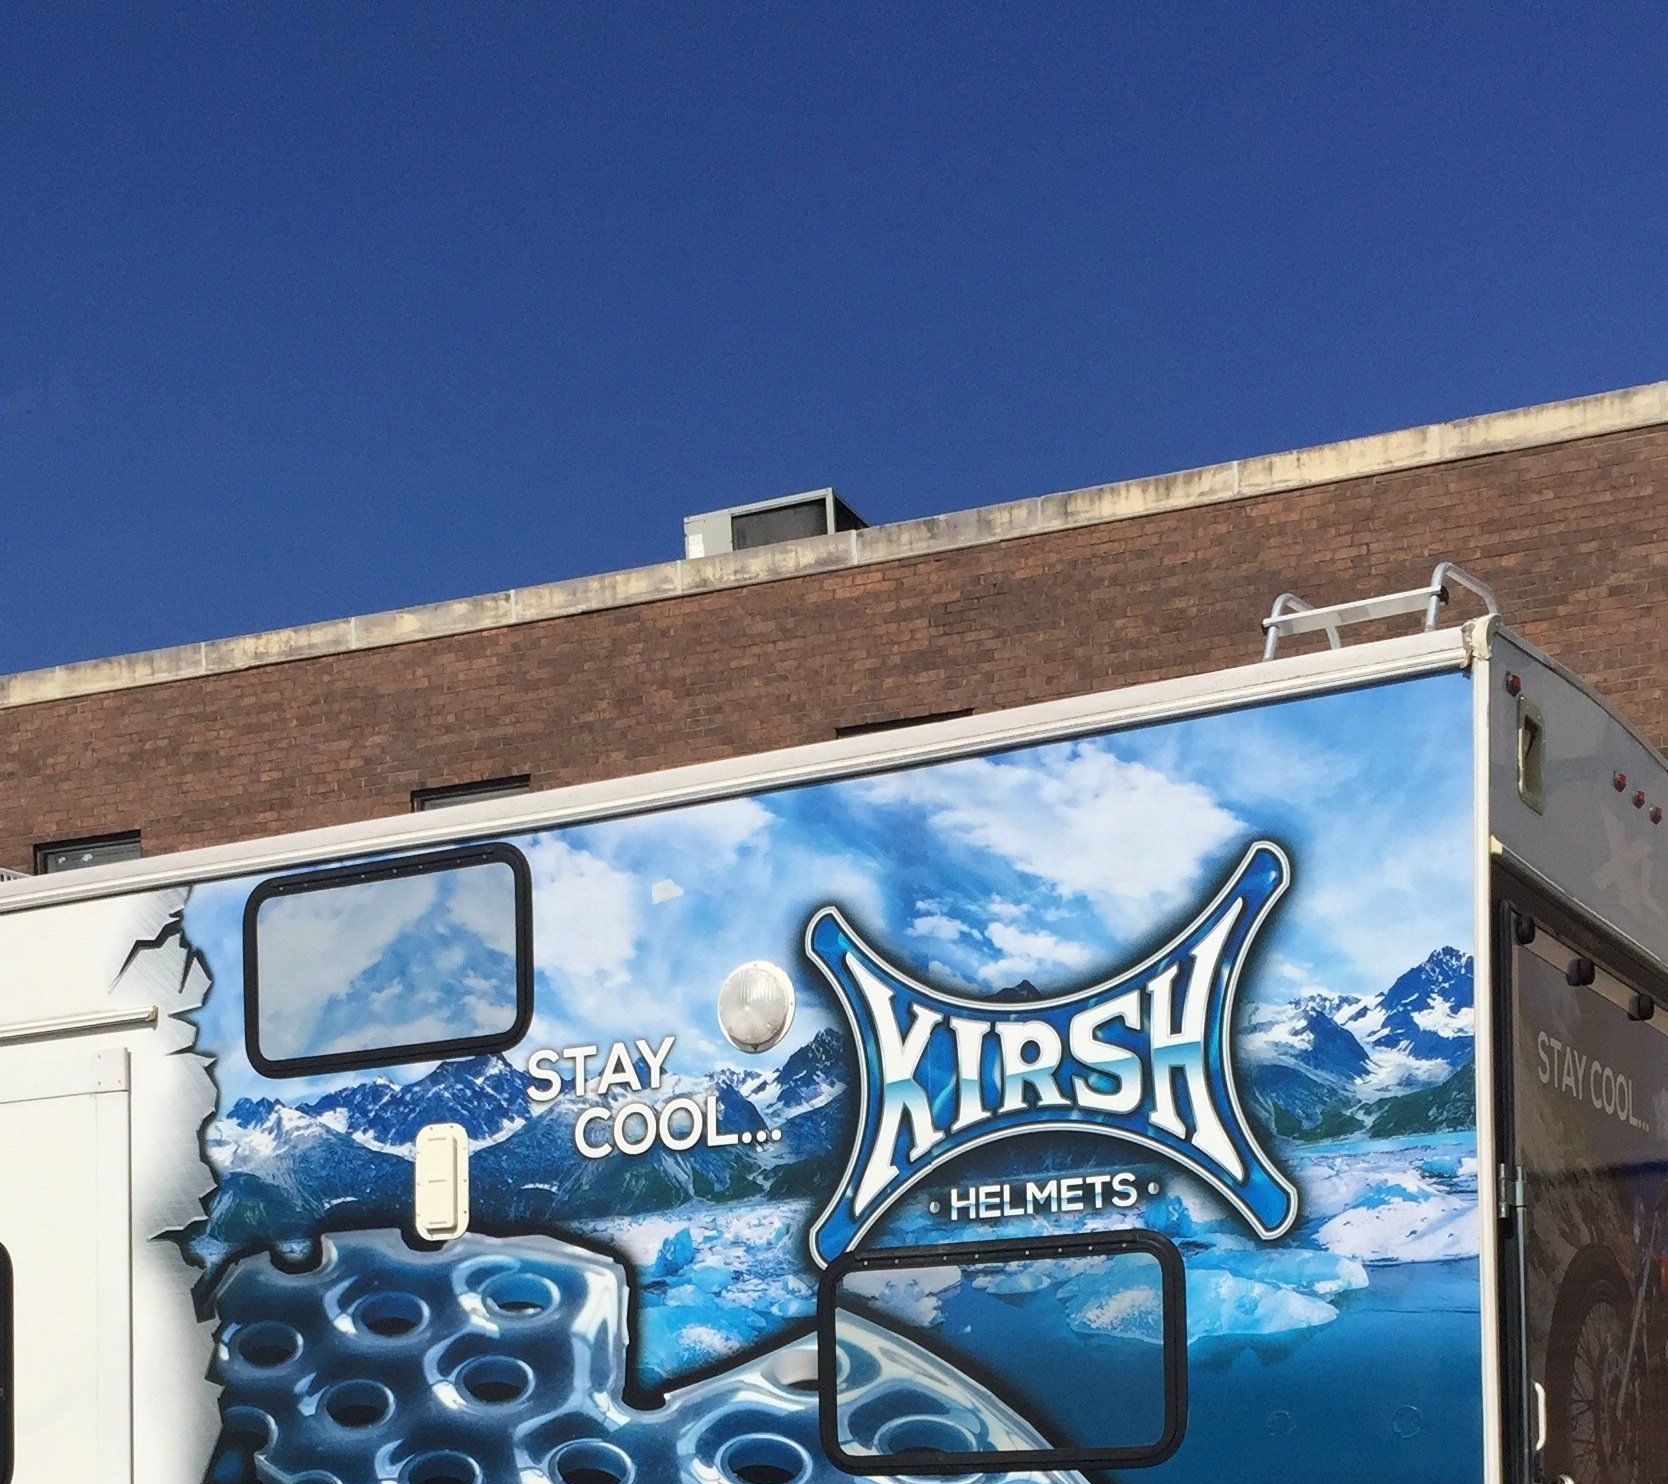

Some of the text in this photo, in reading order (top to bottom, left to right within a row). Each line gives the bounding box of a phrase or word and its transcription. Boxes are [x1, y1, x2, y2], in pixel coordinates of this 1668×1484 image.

[527, 1036, 676, 1101] STAY
[846, 897, 1244, 1214] KIRSH
[1538, 1030, 1586, 1100] STAY
[574, 1097, 782, 1158] COOL...
[950, 1172, 1138, 1221] HELMETS
